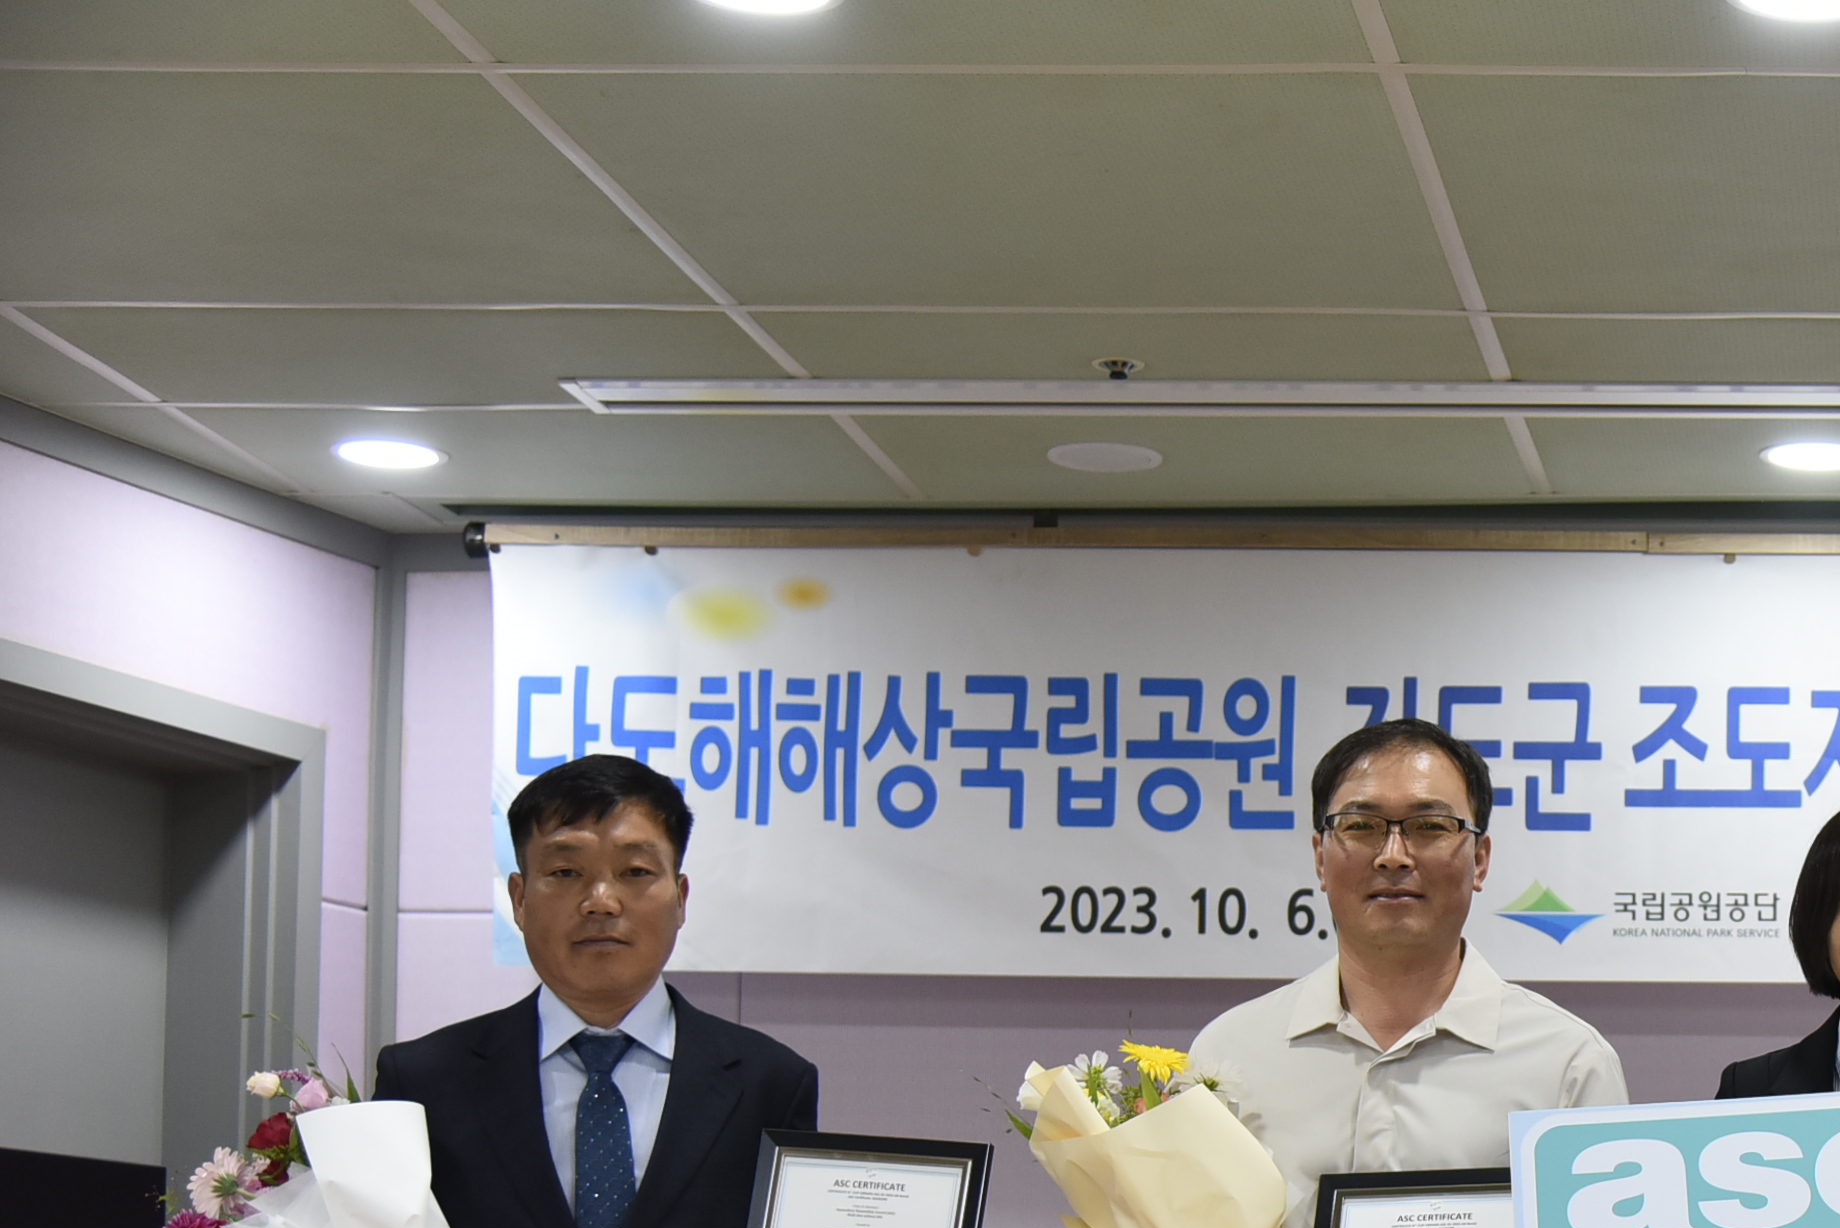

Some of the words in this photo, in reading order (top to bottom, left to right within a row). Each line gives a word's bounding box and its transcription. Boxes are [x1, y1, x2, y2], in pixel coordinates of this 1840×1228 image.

[515, 665, 1296, 832] 다도해해상국립공원
[1346, 676, 1602, 832] 도군
[1040, 885, 1172, 938] 2023.
[1190, 887, 1258, 939] 10.
[1287, 888, 1328, 940] 6.
[1613, 891, 1780, 922] 국립공원공단
[1613, 927, 1648, 938] KOREA
[1651, 927, 1703, 938] NATIONAL
[1706, 928, 1734, 938] PARK
[1736, 928, 1781, 938] SERVICE
[833, 1179, 851, 1188] ASC
[852, 1180, 906, 1192] CERTIFICATE
[1397, 1214, 1415, 1222] ASC
[1417, 1212, 1473, 1222] CERTIFICATE
